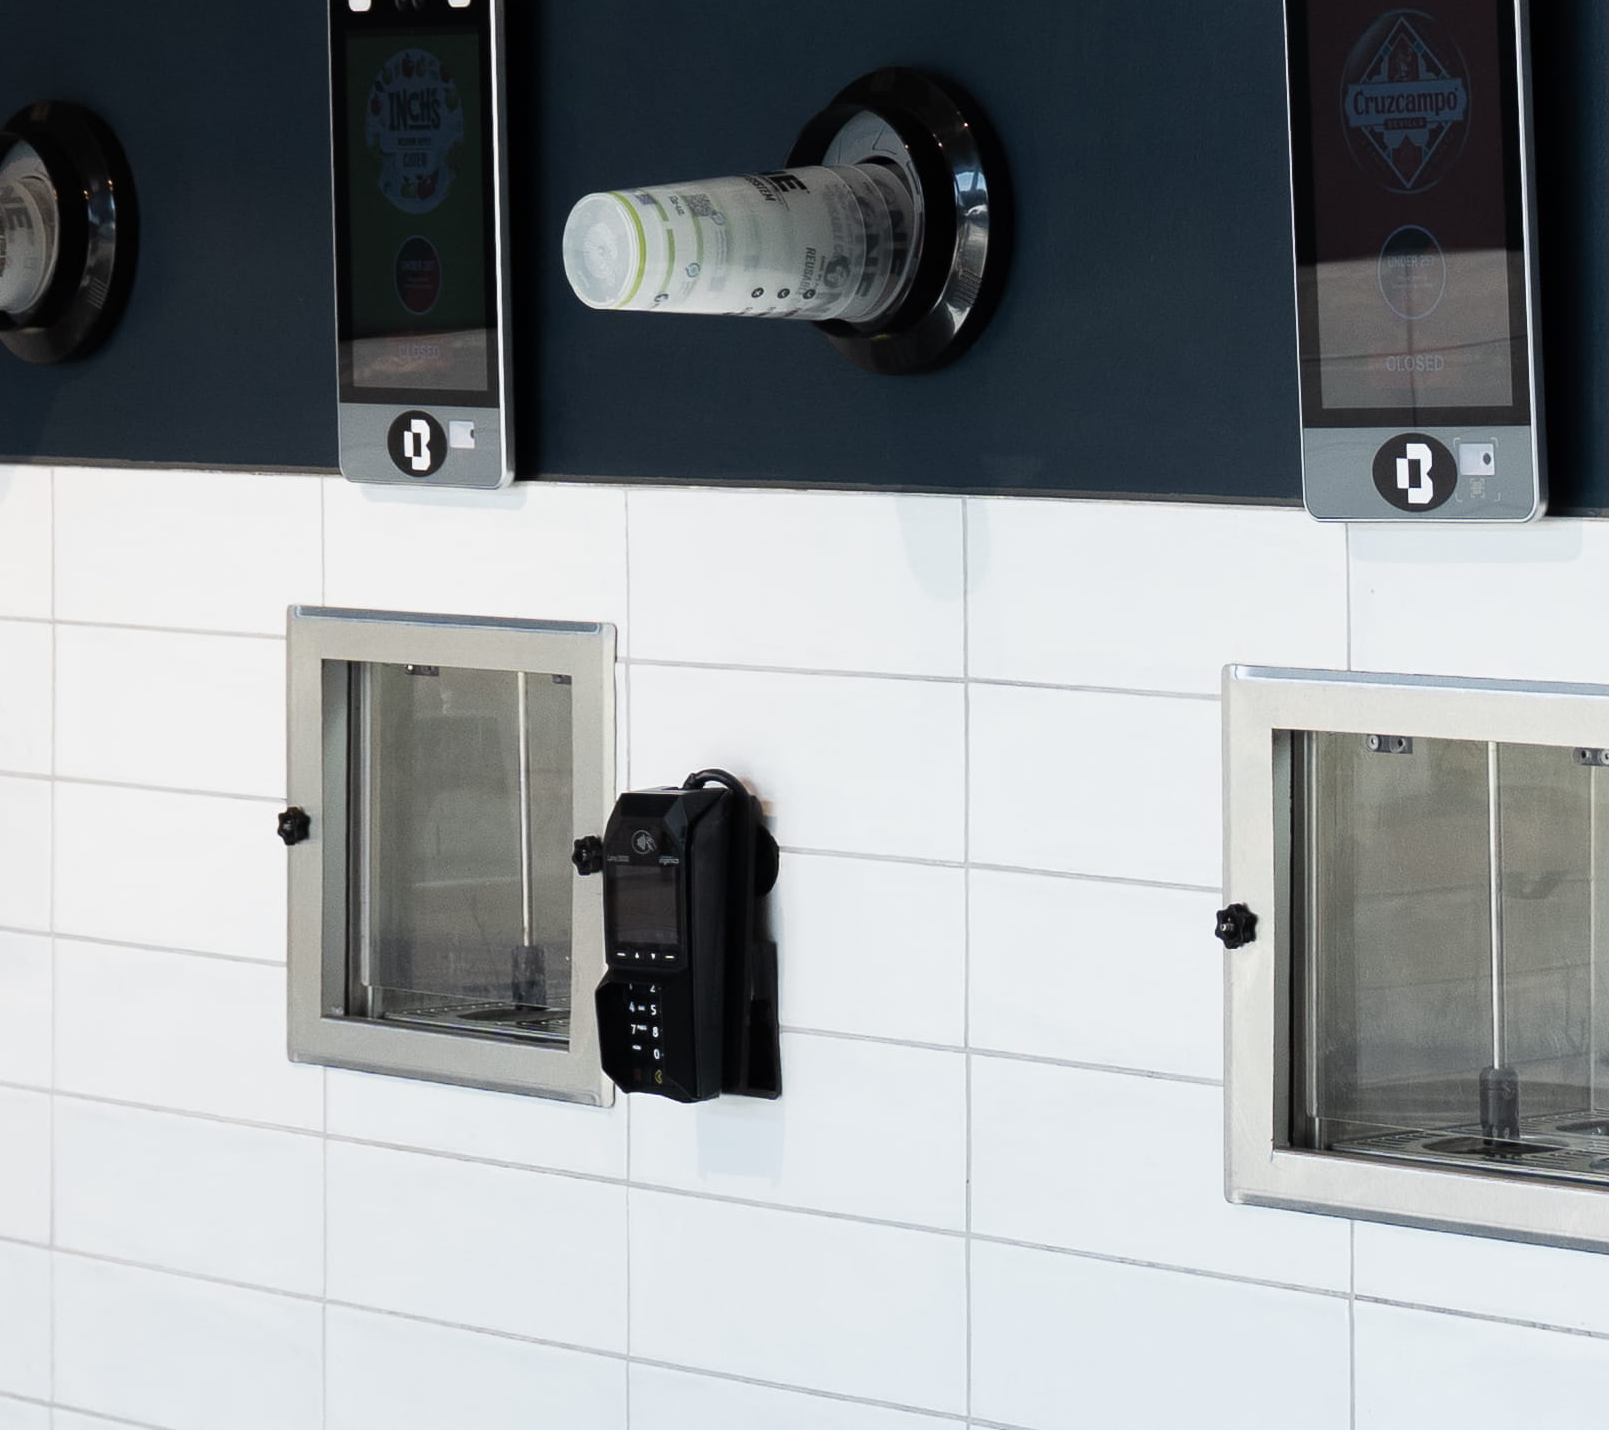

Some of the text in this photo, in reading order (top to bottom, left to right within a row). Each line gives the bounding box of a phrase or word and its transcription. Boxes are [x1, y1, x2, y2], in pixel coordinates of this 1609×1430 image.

[1352, 88, 1458, 117] Cruzcampo
[1385, 354, 1444, 372] CLOSED
[652, 1026, 660, 1038] 8
